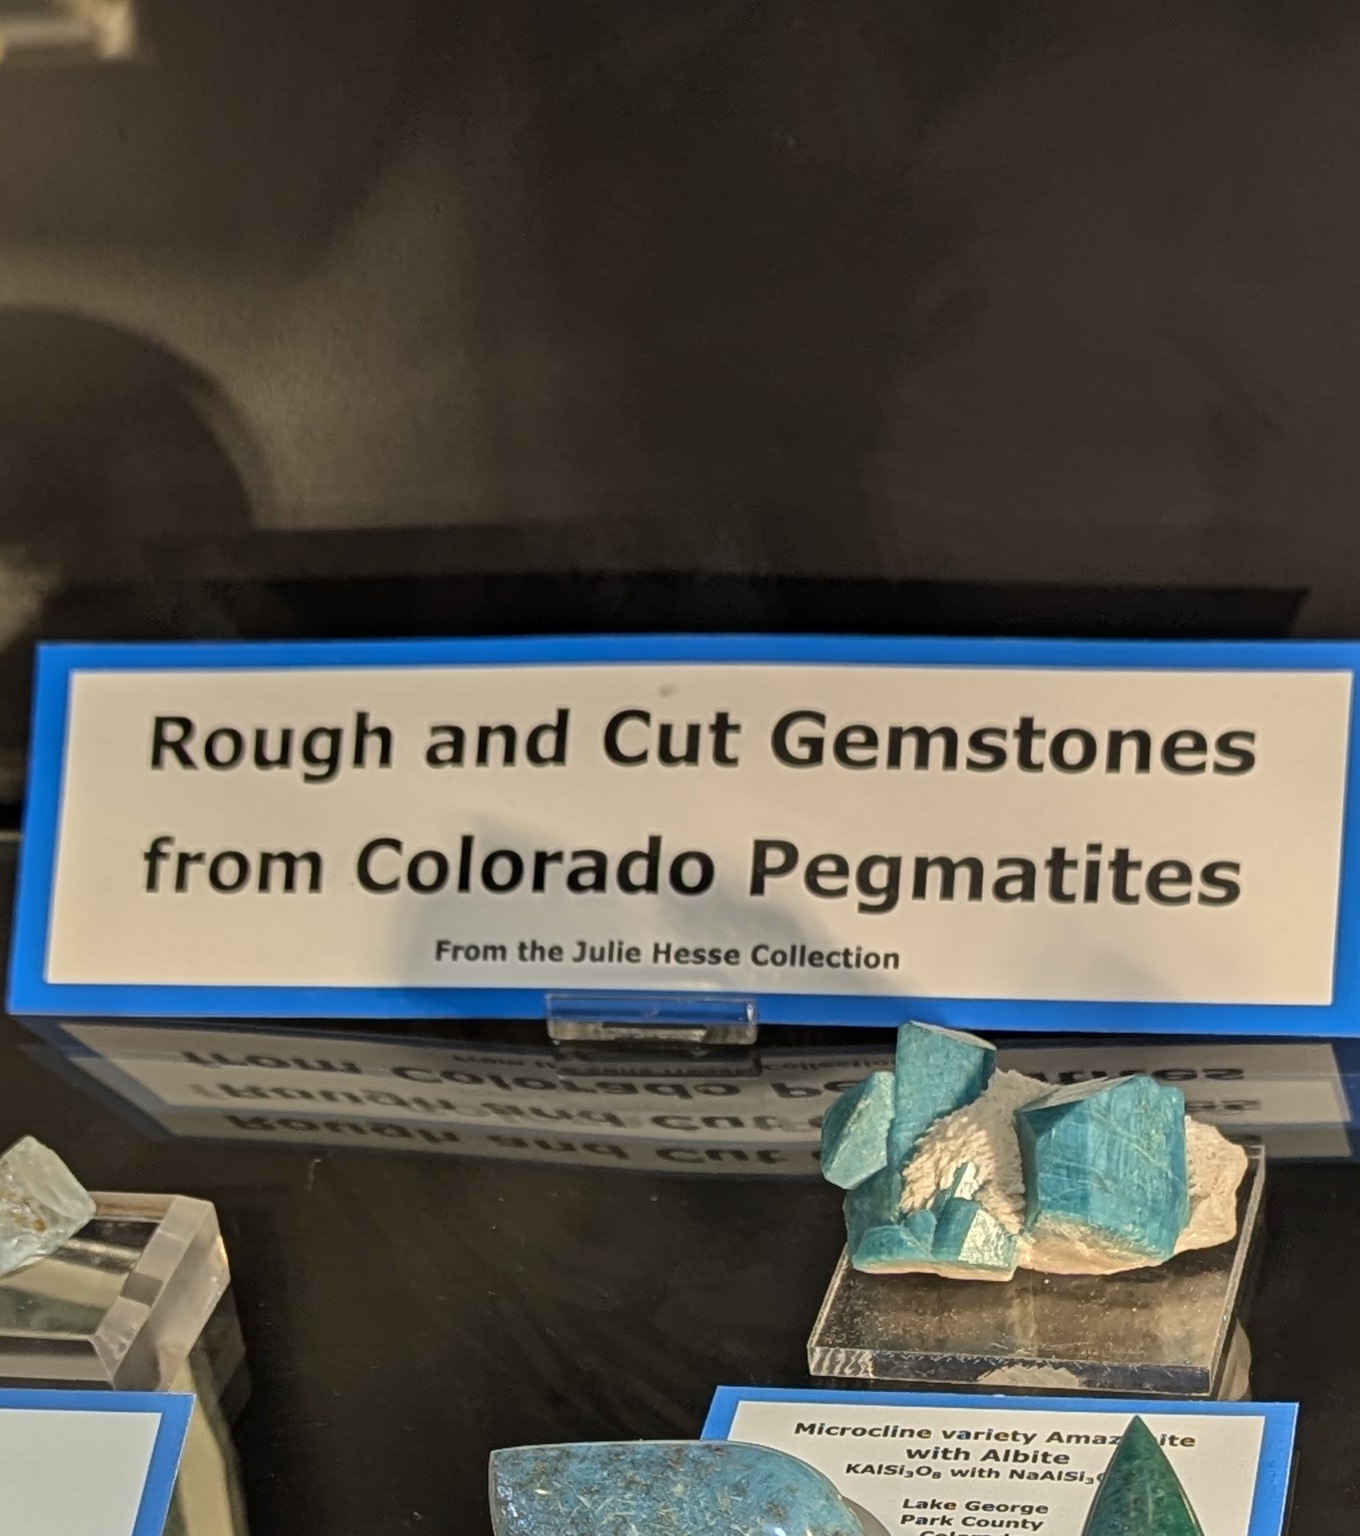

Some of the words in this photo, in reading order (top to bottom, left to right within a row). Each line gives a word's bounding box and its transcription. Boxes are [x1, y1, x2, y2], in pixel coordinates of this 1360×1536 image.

[148, 711, 393, 781] Rough
[425, 710, 570, 768] and
[602, 710, 740, 770] Cut
[769, 711, 1257, 776] Gemstones
[140, 838, 324, 895] from
[355, 836, 715, 898] Colorado
[749, 838, 1243, 912] Pegmatites
[434, 939, 509, 965] From
[519, 941, 564, 964] the
[572, 940, 642, 966] Julie
[650, 942, 741, 968] Hesse
[750, 943, 900, 970] Collection
[794, 1422, 932, 1440] Microcline
[941, 1428, 1038, 1446] variety
[1045, 1431, 1196, 1448] Amazite
[906, 1446, 971, 1462] with
[980, 1449, 1070, 1465] Albite
[951, 1467, 1000, 1480] with
[902, 1498, 956, 1512] Lake
[965, 1499, 1049, 1518] George
[899, 1514, 956, 1528] Park
[961, 1516, 1044, 1533] County
